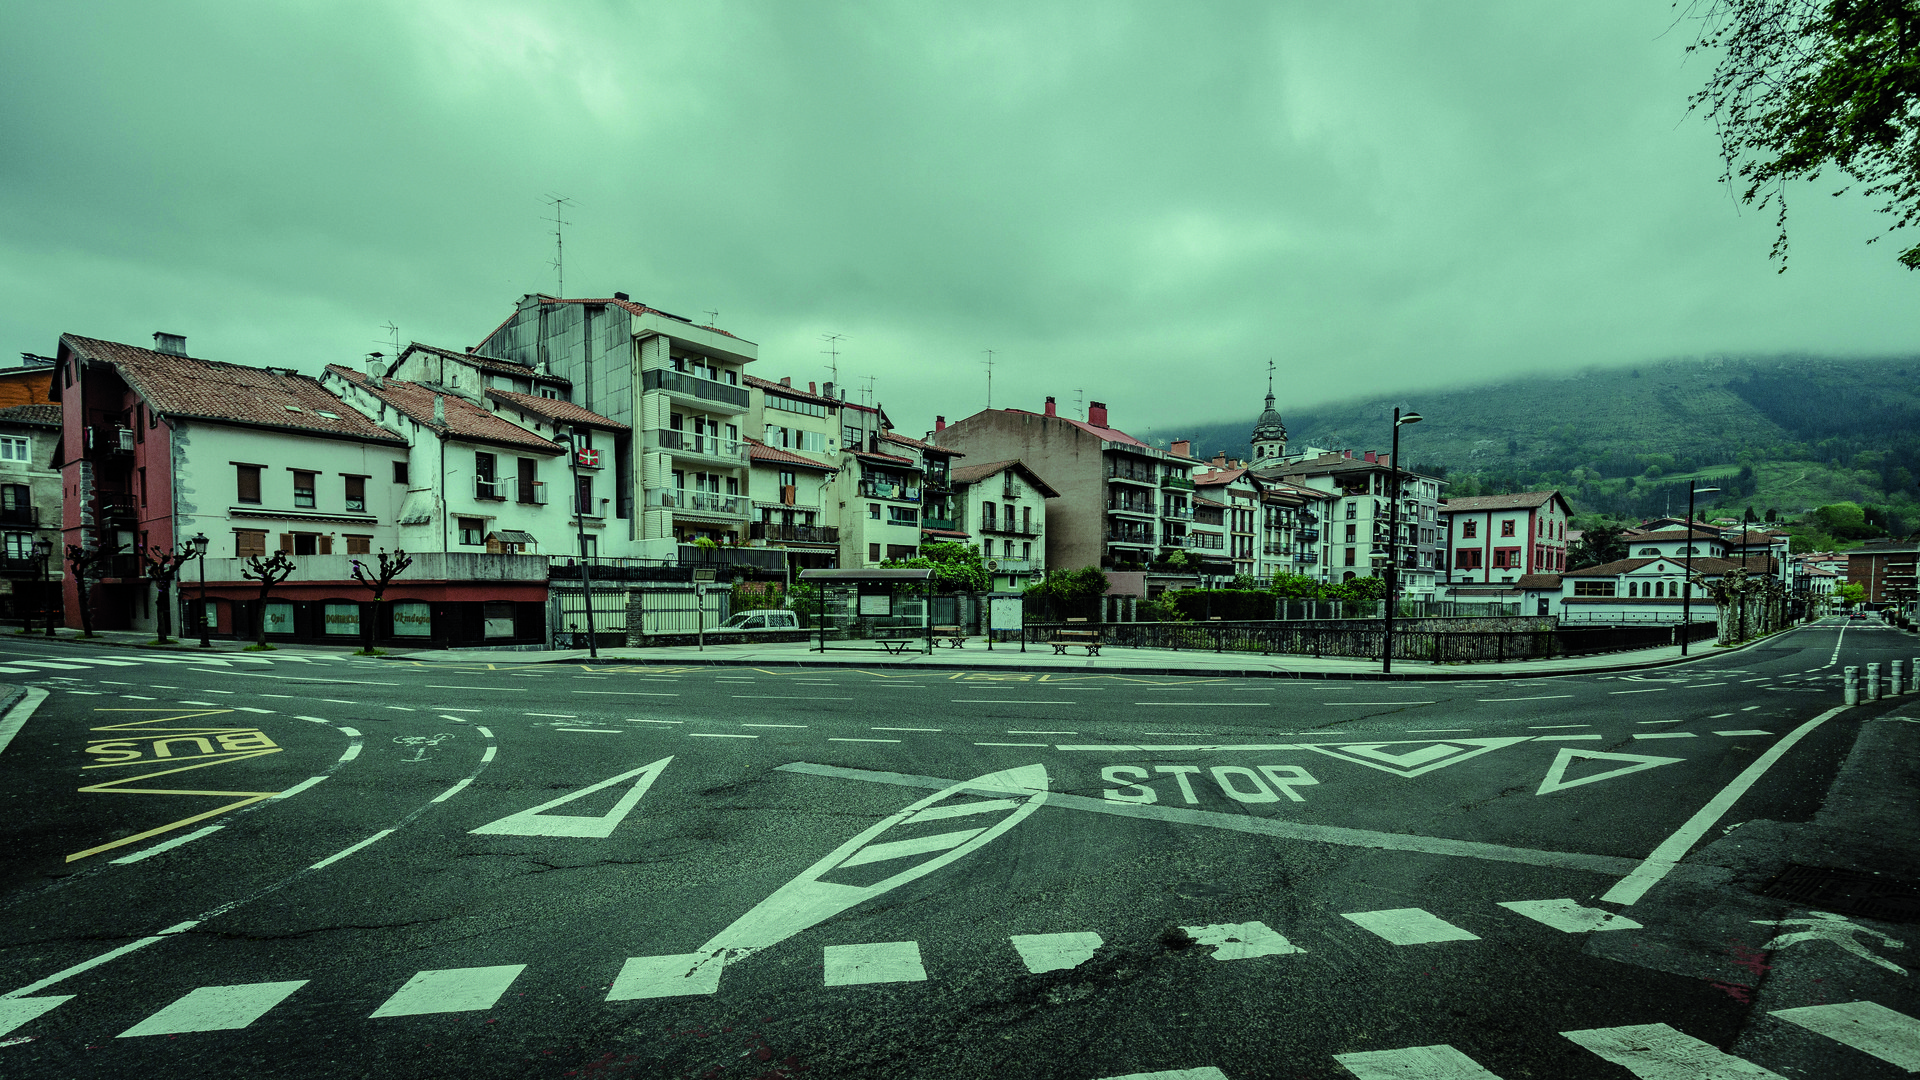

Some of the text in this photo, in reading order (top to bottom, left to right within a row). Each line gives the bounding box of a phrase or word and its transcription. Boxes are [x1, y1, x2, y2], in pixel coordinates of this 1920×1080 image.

[270, 613, 285, 625] Opil
[85, 731, 278, 762] BUS
[1101, 765, 1320, 805] STOP
